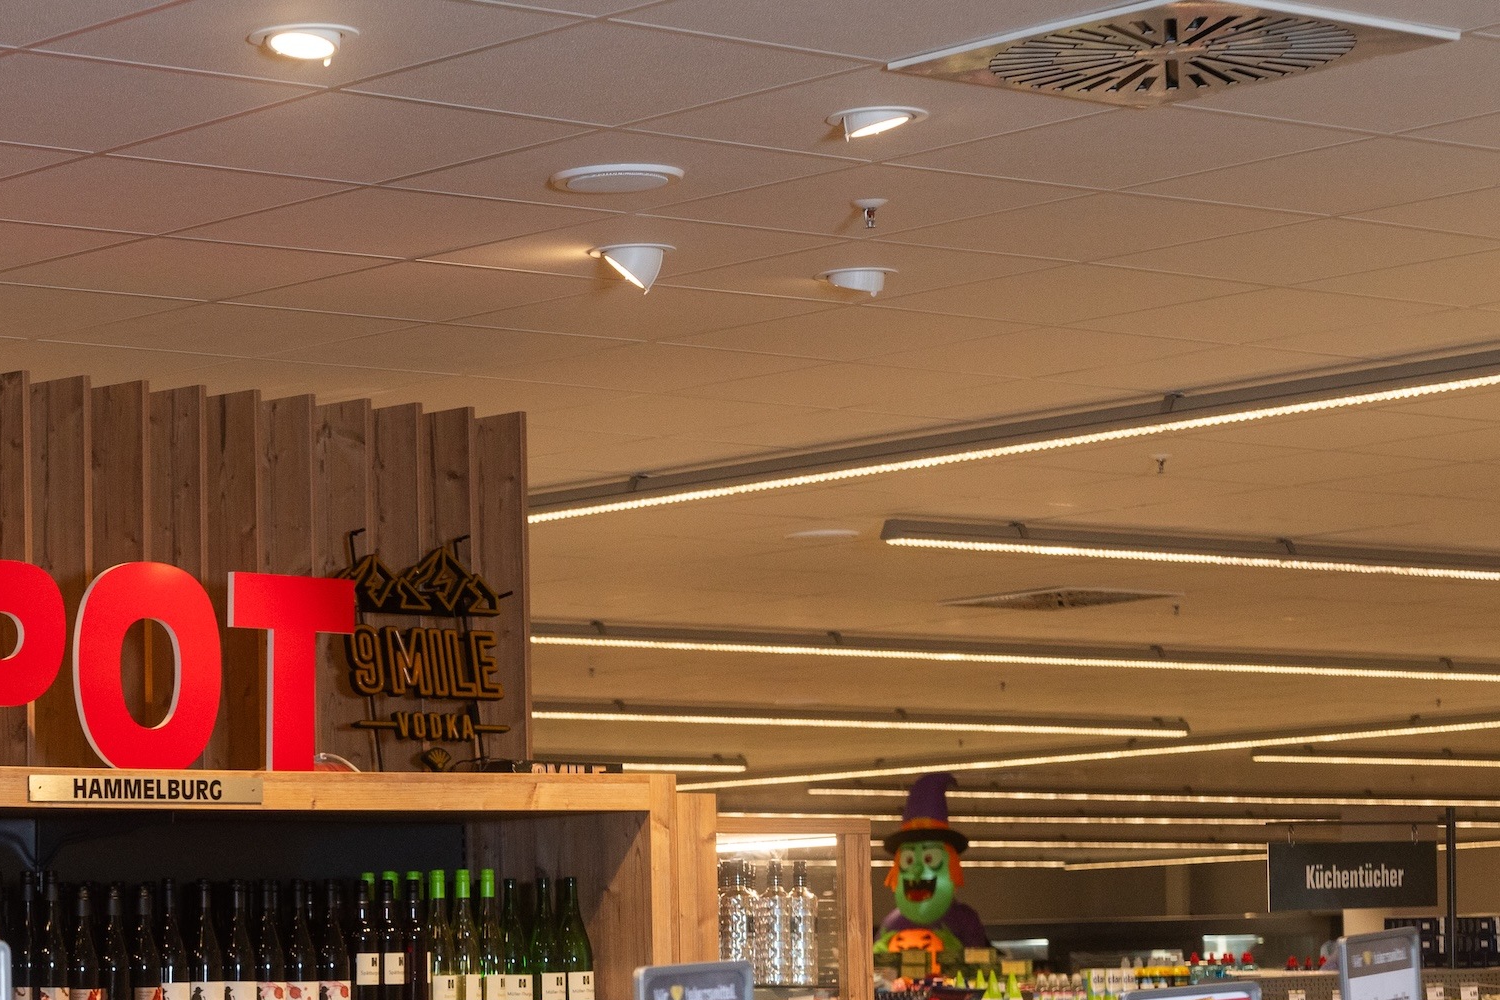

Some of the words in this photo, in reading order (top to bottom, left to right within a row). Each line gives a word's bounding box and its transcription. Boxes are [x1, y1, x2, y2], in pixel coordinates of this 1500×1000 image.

[395, 711, 476, 741] VODKA
[72, 777, 223, 803] HAMMELBURG
[1305, 864, 1405, 890] Küchentücher
